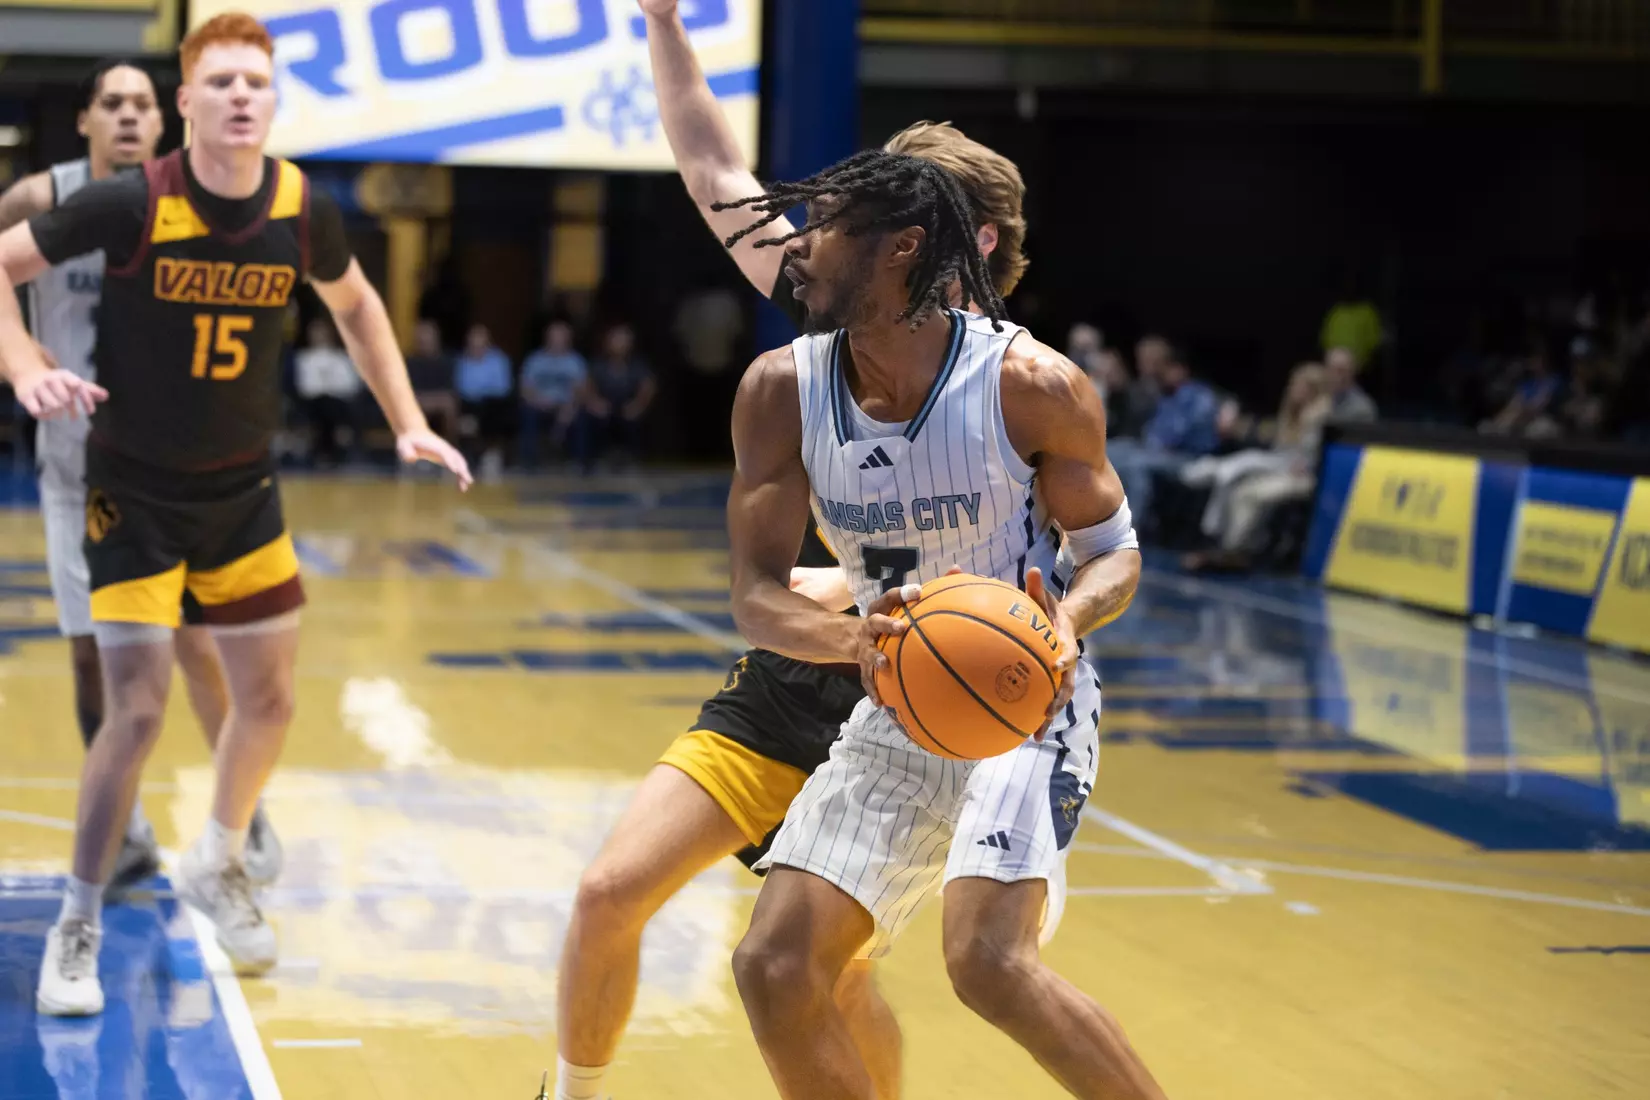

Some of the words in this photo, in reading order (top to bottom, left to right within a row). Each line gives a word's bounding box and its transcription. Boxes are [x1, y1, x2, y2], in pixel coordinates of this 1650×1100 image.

[153, 256, 296, 307] VALOR
[190, 314, 254, 381] 15
[911, 492, 981, 531] CITY
